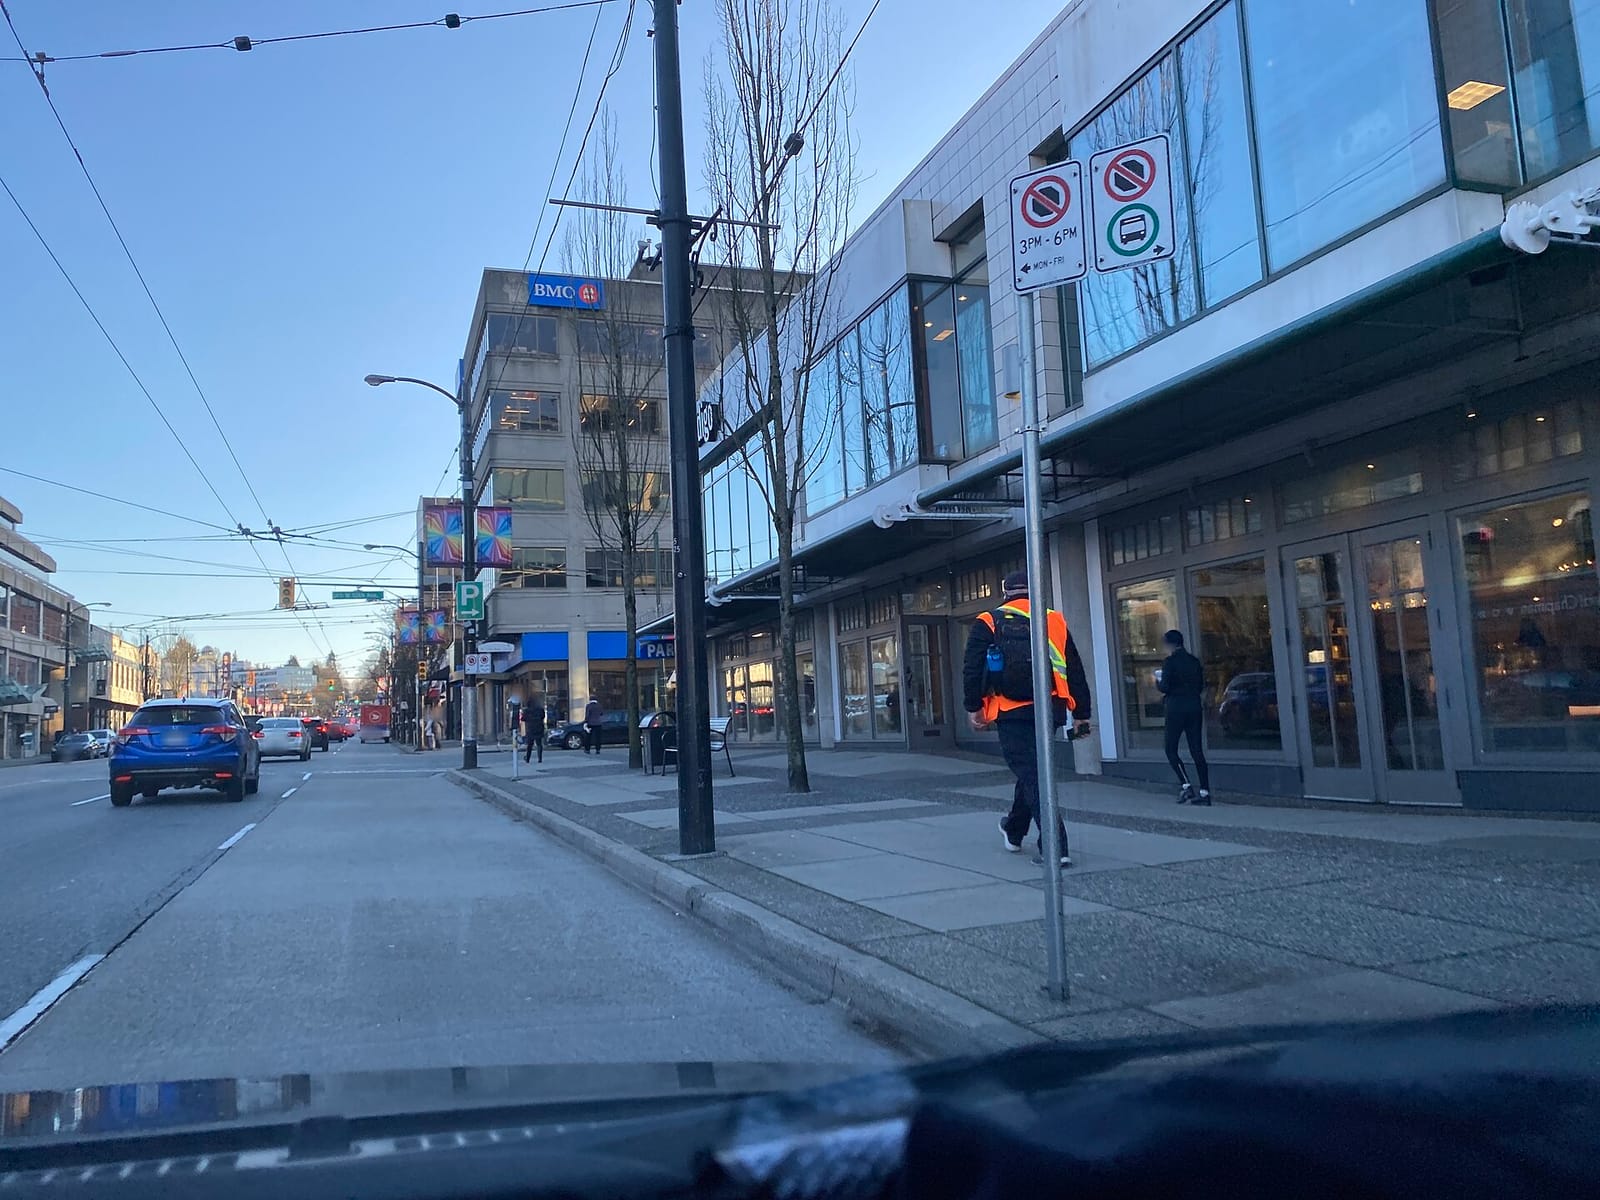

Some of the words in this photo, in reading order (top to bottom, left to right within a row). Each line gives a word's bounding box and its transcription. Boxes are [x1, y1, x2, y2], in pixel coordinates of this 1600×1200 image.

[1020, 235, 1042, 255] 3PM
[1054, 226, 1077, 246] 6PM
[1033, 256, 1064, 271] MON-FRI
[461, 585, 479, 606] P
[647, 643, 675, 658] PAR
